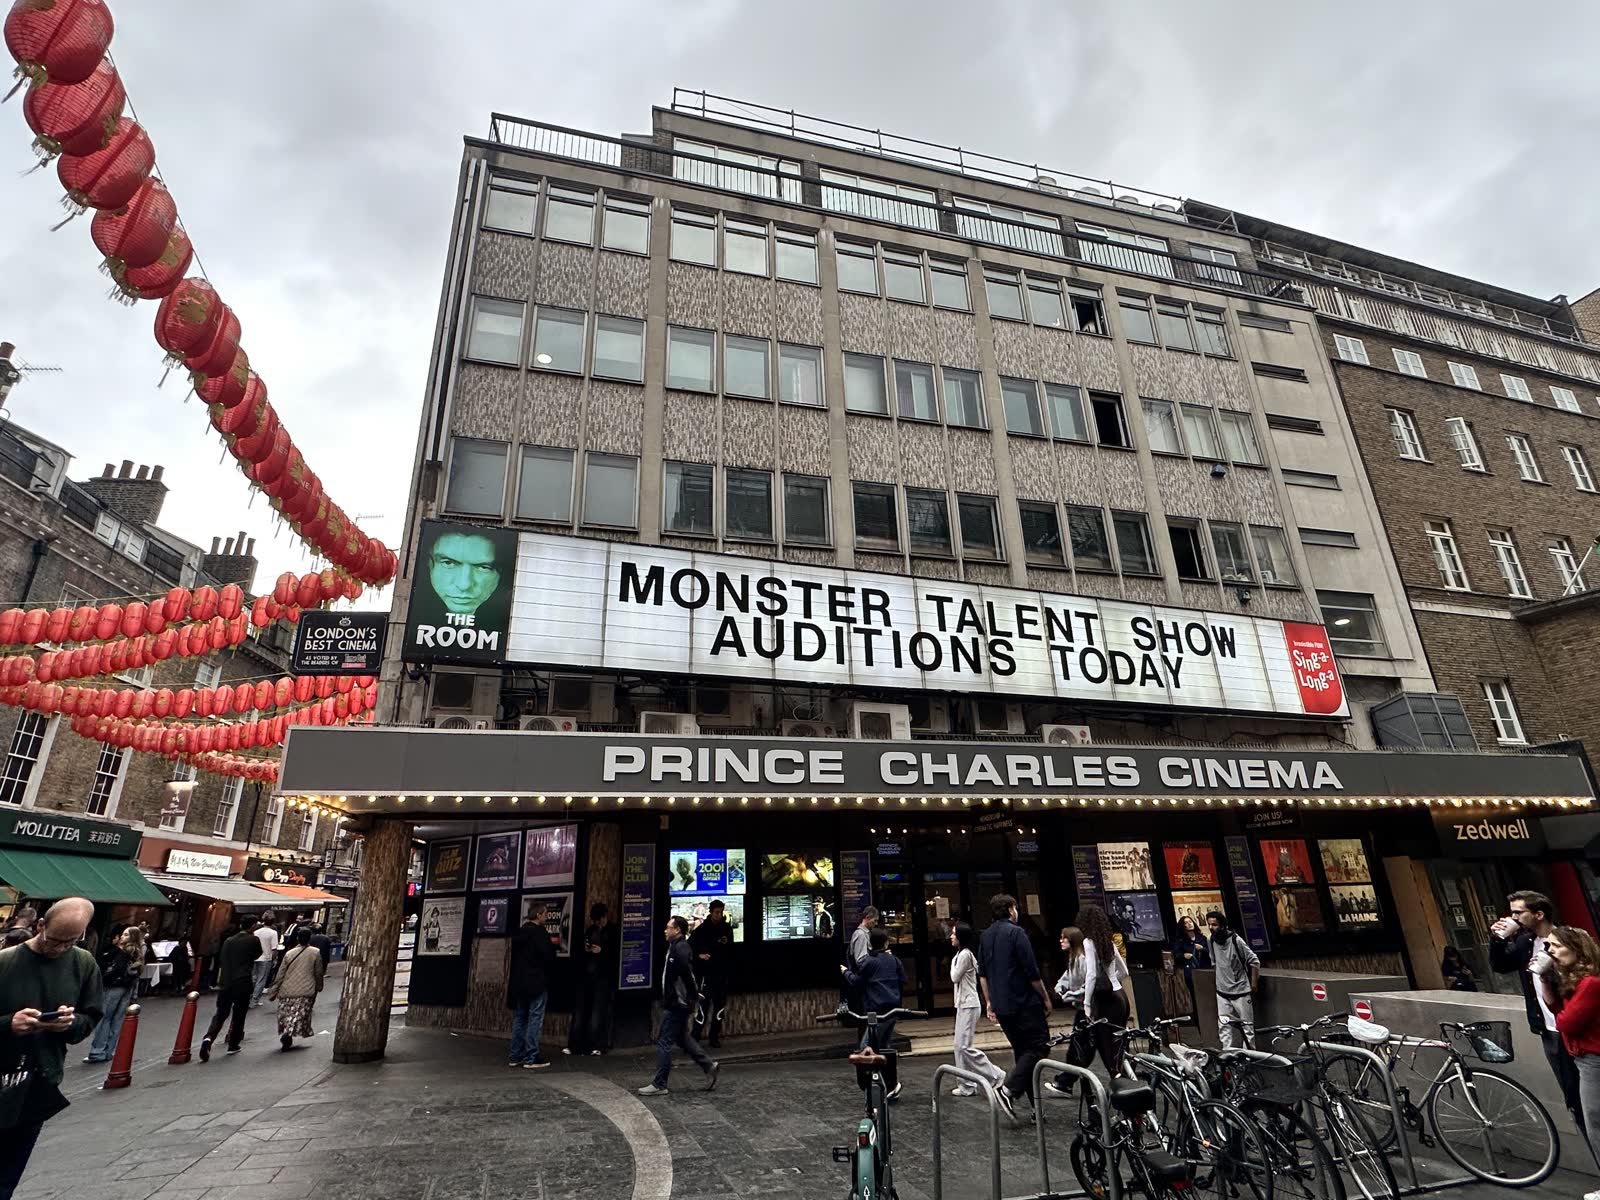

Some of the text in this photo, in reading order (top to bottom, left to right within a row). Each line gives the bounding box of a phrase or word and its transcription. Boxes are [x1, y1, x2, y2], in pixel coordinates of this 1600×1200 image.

[618, 561, 1236, 659] MONSTER TALENT SHOW
[445, 612, 476, 626] THE
[306, 626, 377, 639] LONDON'S
[415, 624, 499, 651] ROOM
[304, 640, 377, 651] BEST CINEMA
[709, 615, 1183, 688] AUDITIONS TODAY
[1297, 669, 1335, 692] Long-a
[603, 745, 1344, 791] PRINCE CHARLES CINEMA
[1453, 818, 1530, 841] zedwell
[625, 856, 647, 864] JOIN
[625, 865, 643, 873] THE
[698, 863, 725, 873] 2001
[625, 874, 649, 882] CLUB
[1338, 912, 1379, 922] LA HAINE
